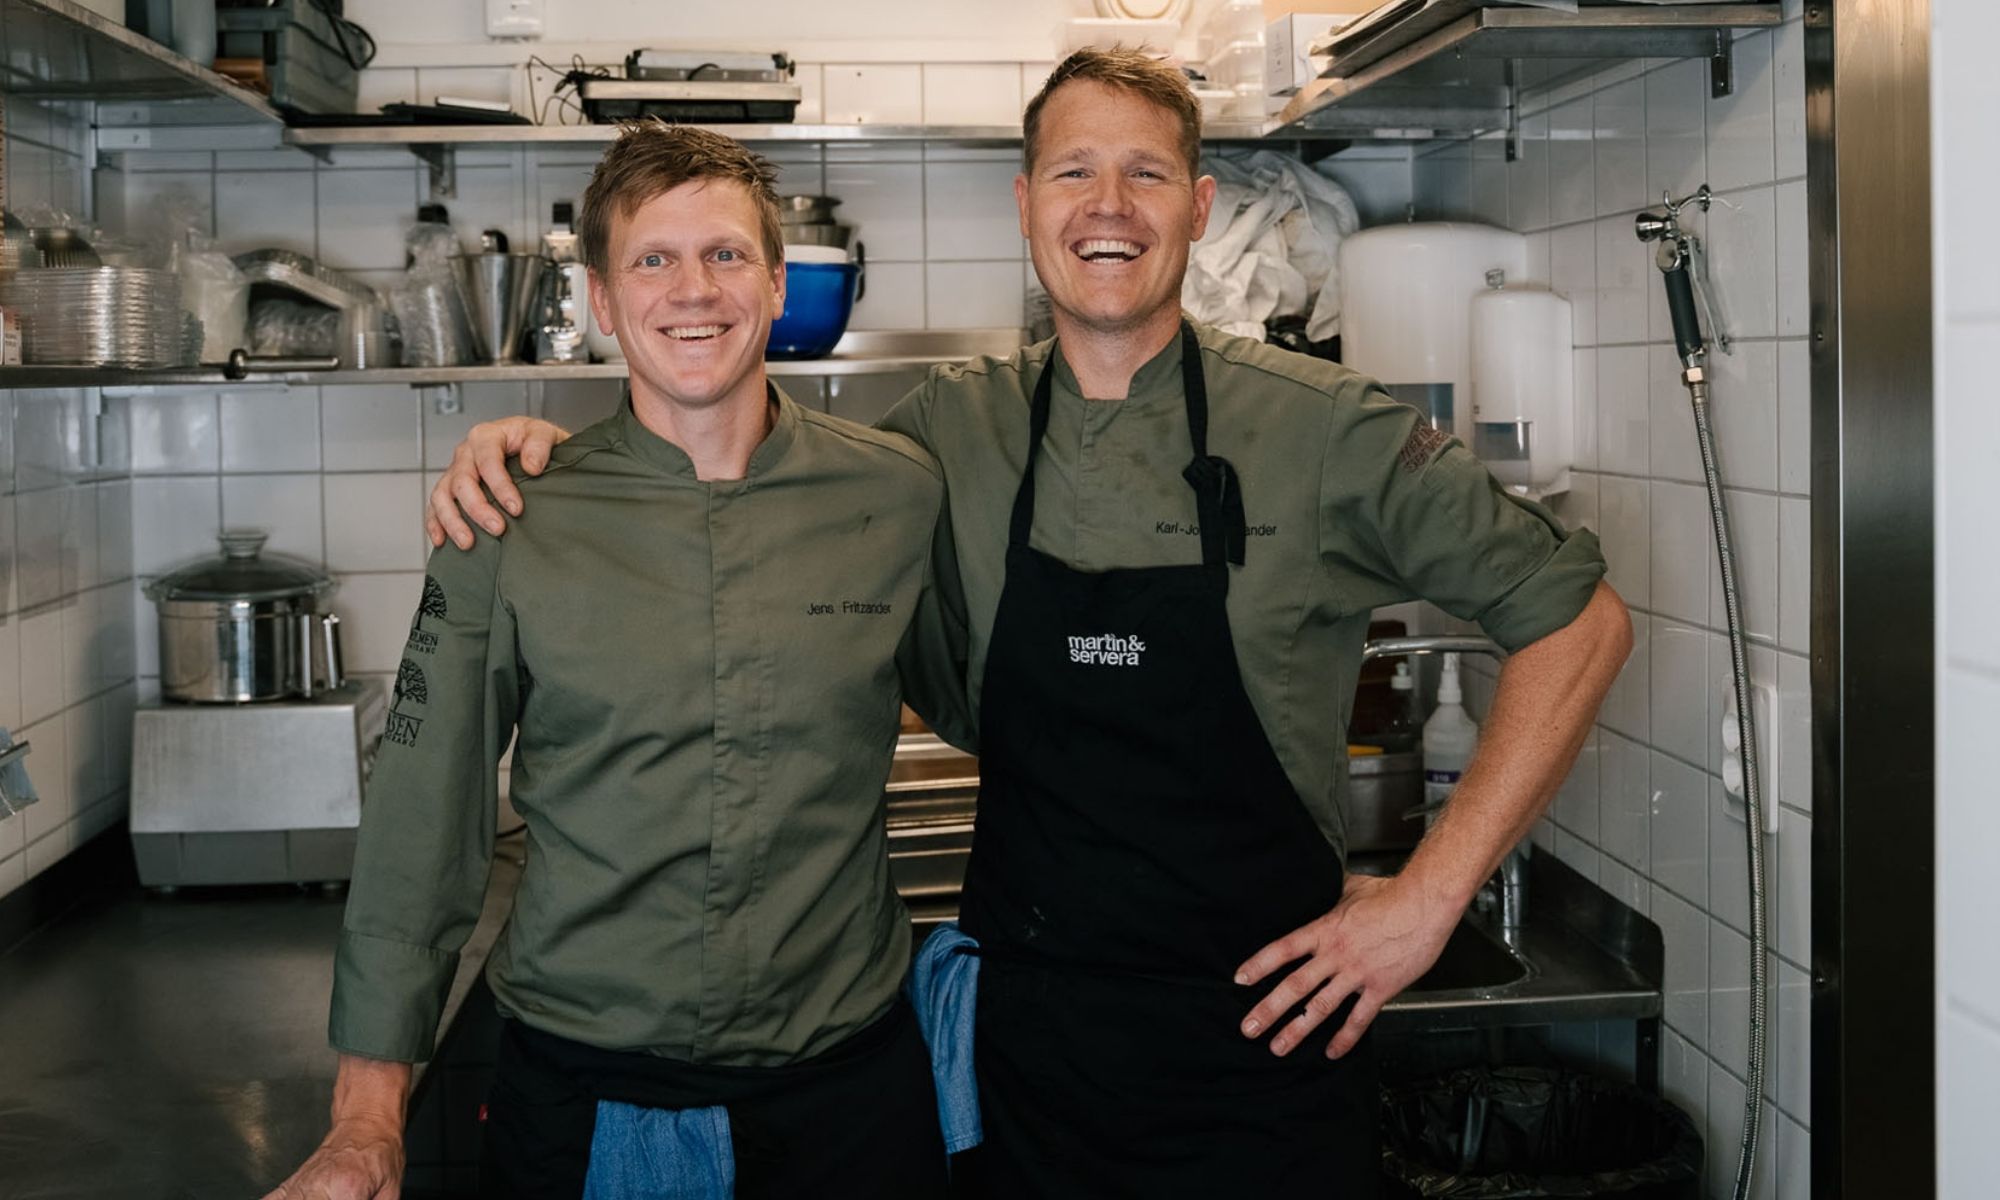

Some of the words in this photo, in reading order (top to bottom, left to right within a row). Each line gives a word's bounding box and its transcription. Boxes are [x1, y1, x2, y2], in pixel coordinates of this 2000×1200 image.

[1156, 521, 1200, 536] Karl-Jo
[1244, 523, 1277, 537] ander
[807, 602, 835, 616] Jens
[842, 601, 892, 614] Fritzander
[1069, 647, 1140, 666] servera
